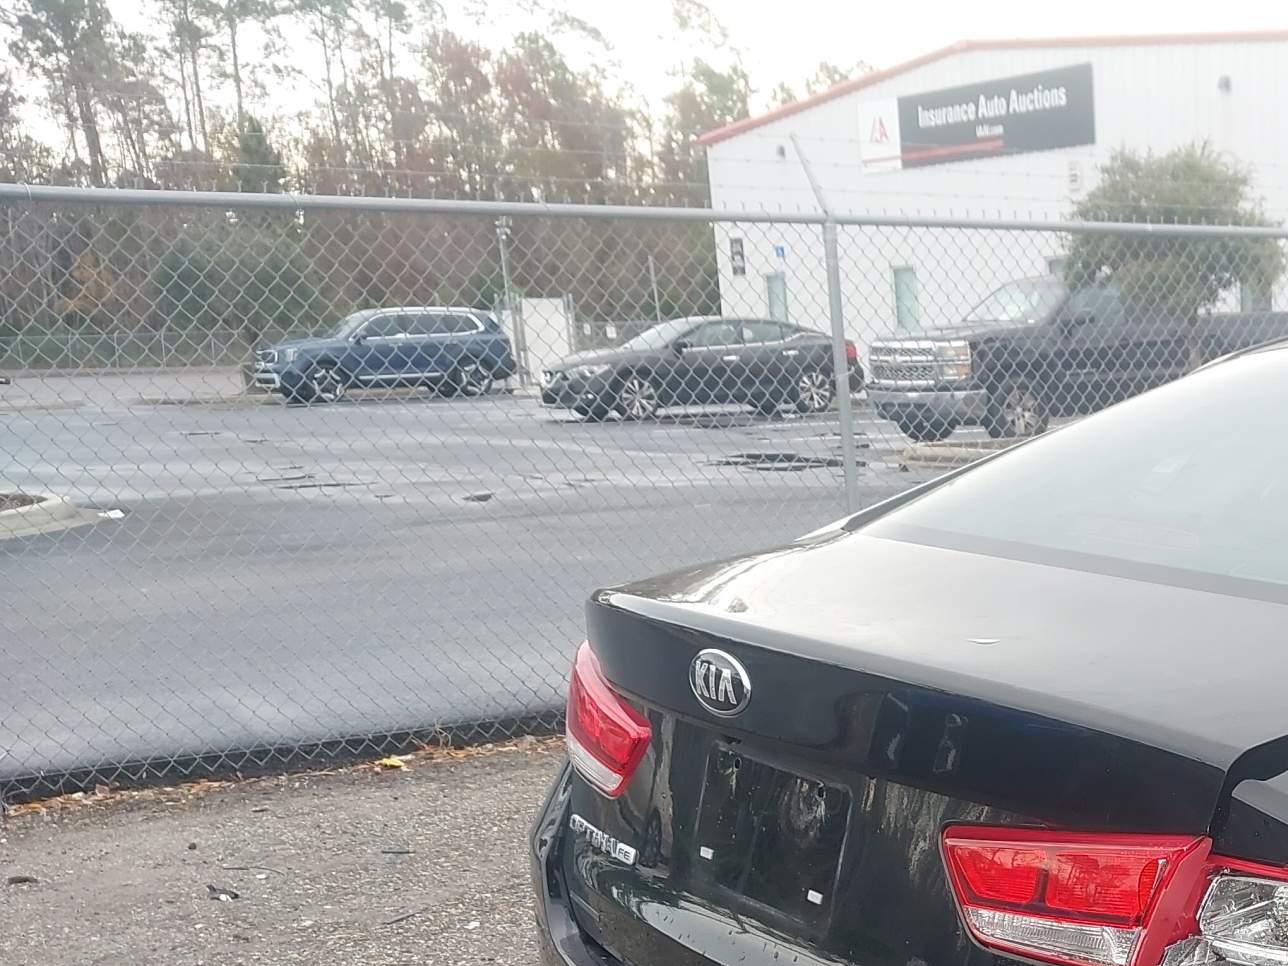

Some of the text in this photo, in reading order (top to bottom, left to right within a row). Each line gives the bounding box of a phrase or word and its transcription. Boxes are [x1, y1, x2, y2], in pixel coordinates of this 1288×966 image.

[917, 84, 1067, 128] Insurance Auto Auctions
[695, 659, 737, 705] KIA
